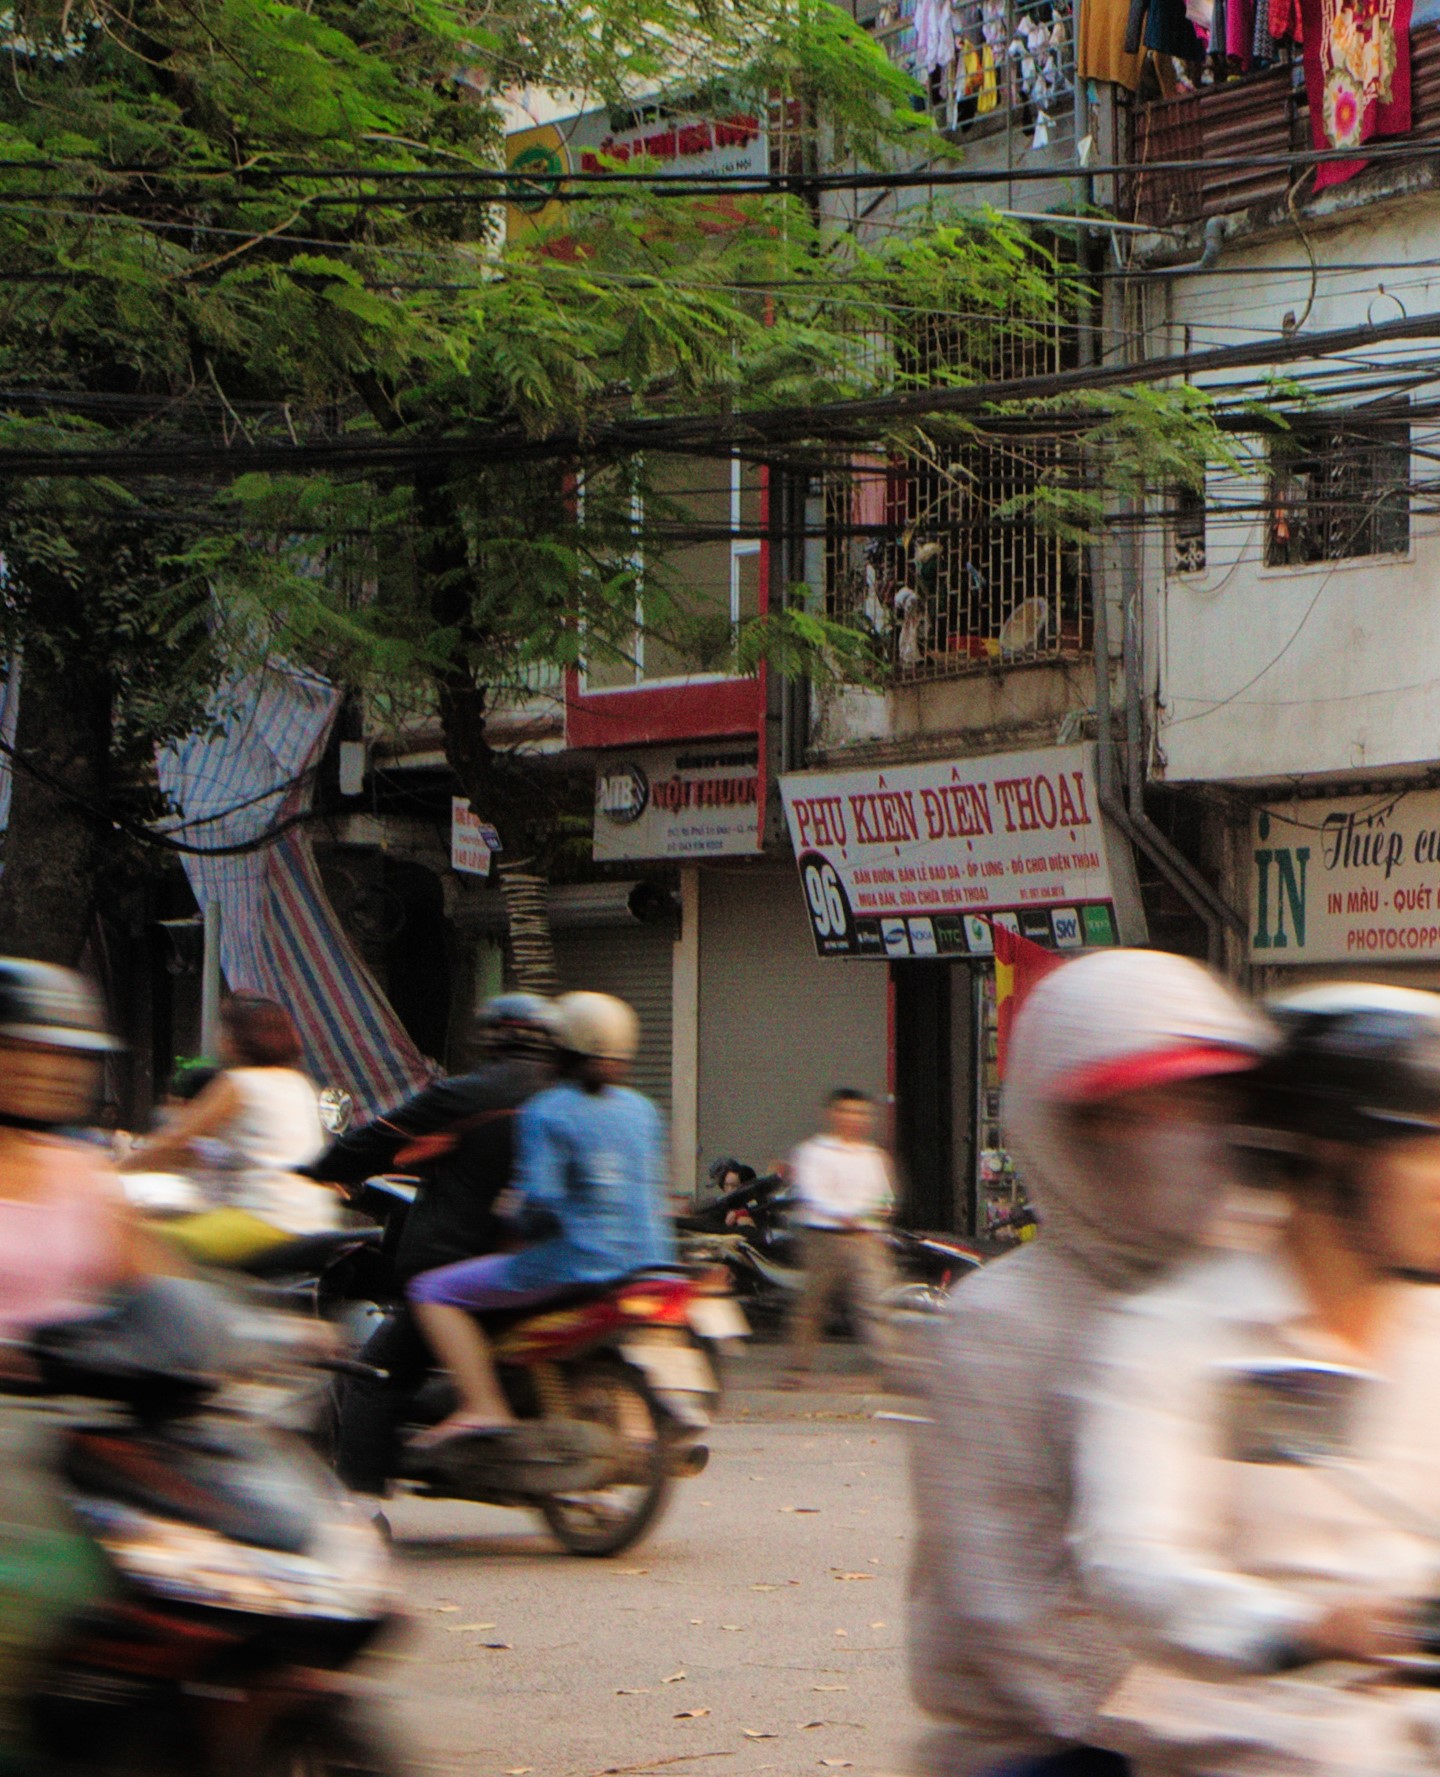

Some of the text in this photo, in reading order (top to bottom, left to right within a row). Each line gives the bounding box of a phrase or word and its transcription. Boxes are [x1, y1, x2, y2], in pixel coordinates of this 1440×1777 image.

[792, 767, 1092, 859] PHỤ KIỆN ĐIỆN THOẠI
[1321, 803, 1405, 879] Thiếp
[853, 869, 871, 885] BÁN
[899, 866, 916, 884] BÁN
[929, 864, 948, 880] BAO
[949, 864, 960, 879] DA
[1072, 853, 1100, 873] THOẠI
[805, 864, 847, 937] 96
[858, 891, 877, 908] MUA
[964, 886, 989, 905] THOẠI
[1328, 893, 1342, 914] IN
[1347, 887, 1379, 913] MÀU
[1393, 883, 1432, 911] QUÉT
[1056, 918, 1077, 939] SKY
